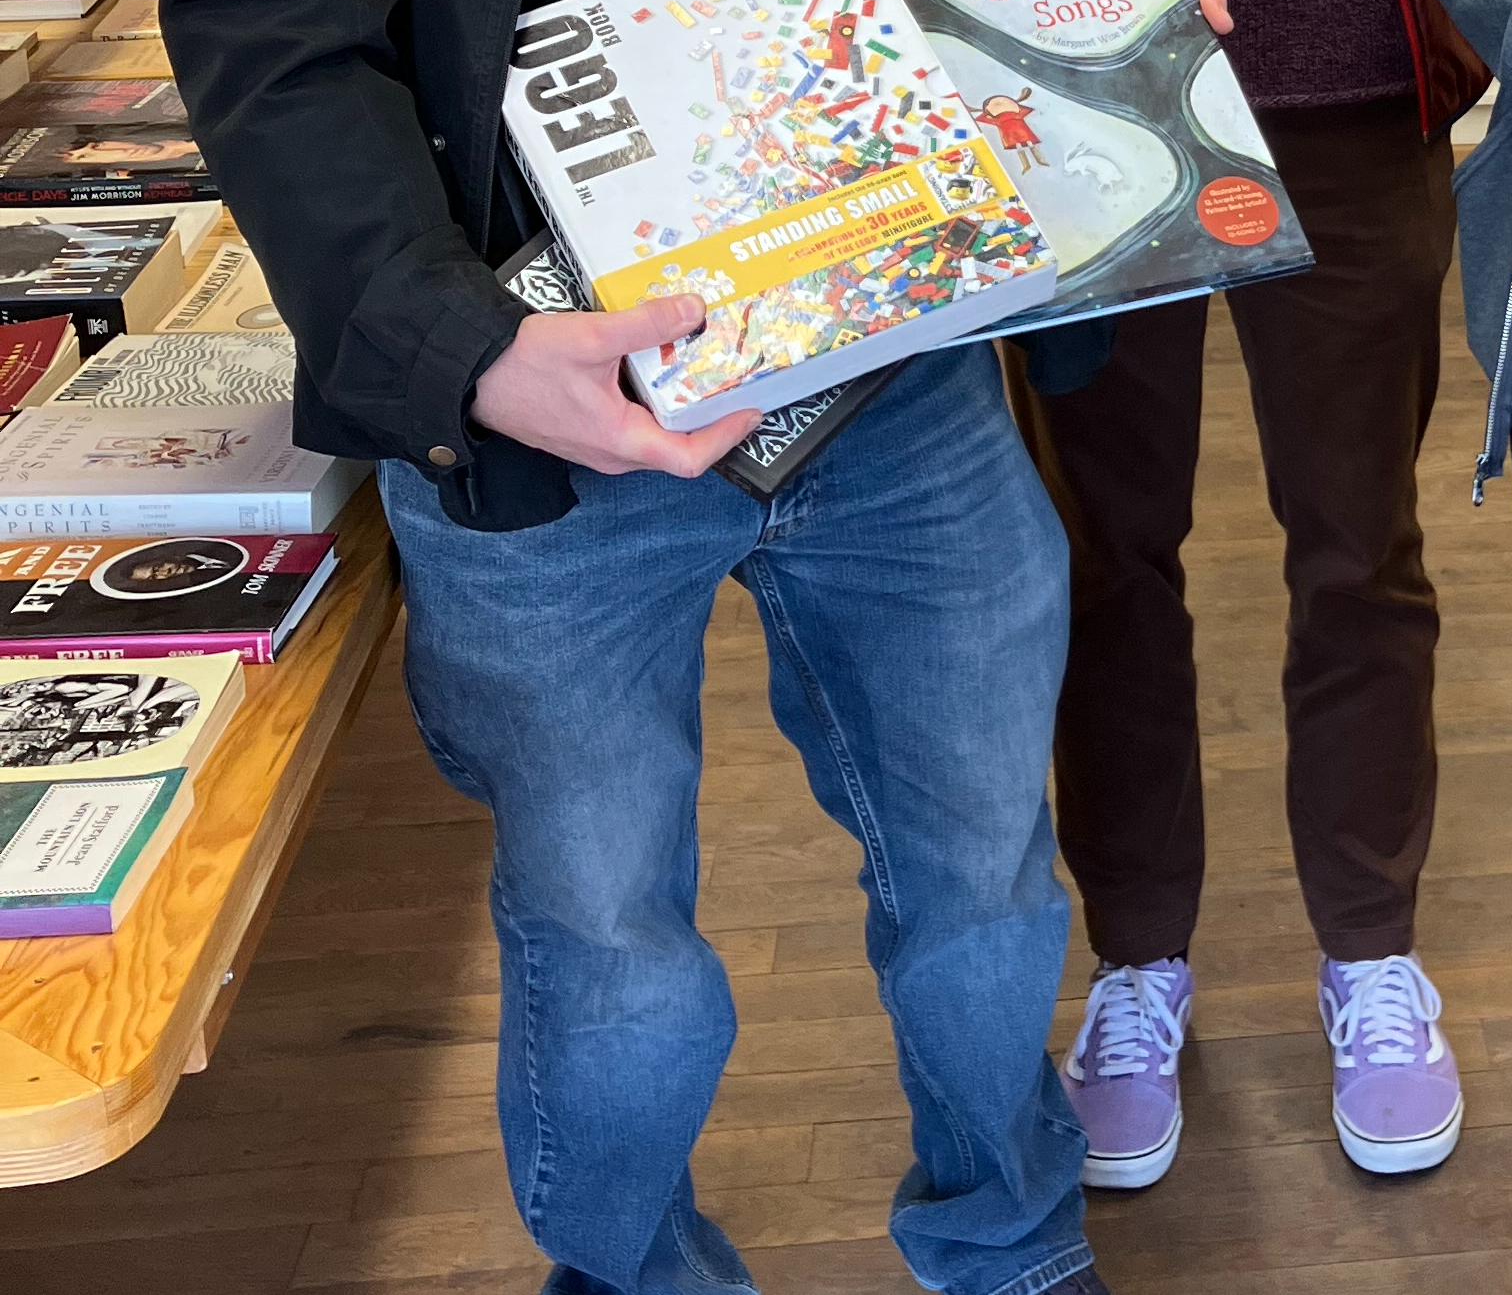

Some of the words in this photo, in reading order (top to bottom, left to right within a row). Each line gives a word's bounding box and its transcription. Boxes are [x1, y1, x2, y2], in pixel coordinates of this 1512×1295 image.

[583, 1, 622, 49] BOOK
[1035, 30, 1049, 44] by
[1050, 34, 1097, 50] Margaret
[1098, 30, 1119, 44] Wise
[1119, 12, 1146, 36] Brown
[509, 14, 657, 184] LEGO
[32, 189, 68, 202] DAYS
[71, 191, 89, 201] JIM
[91, 190, 142, 201] MORRISON
[575, 184, 597, 207] THE
[729, 205, 844, 263] STANDING
[845, 179, 919, 220] SMALL
[794, 232, 854, 259] CELEBRATION
[866, 211, 889, 232] 30
[890, 201, 928, 221] YEARS
[881, 212, 935, 240] MINIFIGURE
[224, 249, 246, 273] MAN
[10, 544, 103, 614] FREE
[13, 545, 51, 577] AND
[241, 574, 270, 596] TOM
[257, 538, 295, 573] SKINNER
[33, 824, 75, 874] MOUNTAIN
[70, 801, 93, 824] LION
[36, 827, 58, 847] THE
[66, 840, 92, 867] Jean
[81, 804, 122, 845] Stafford
